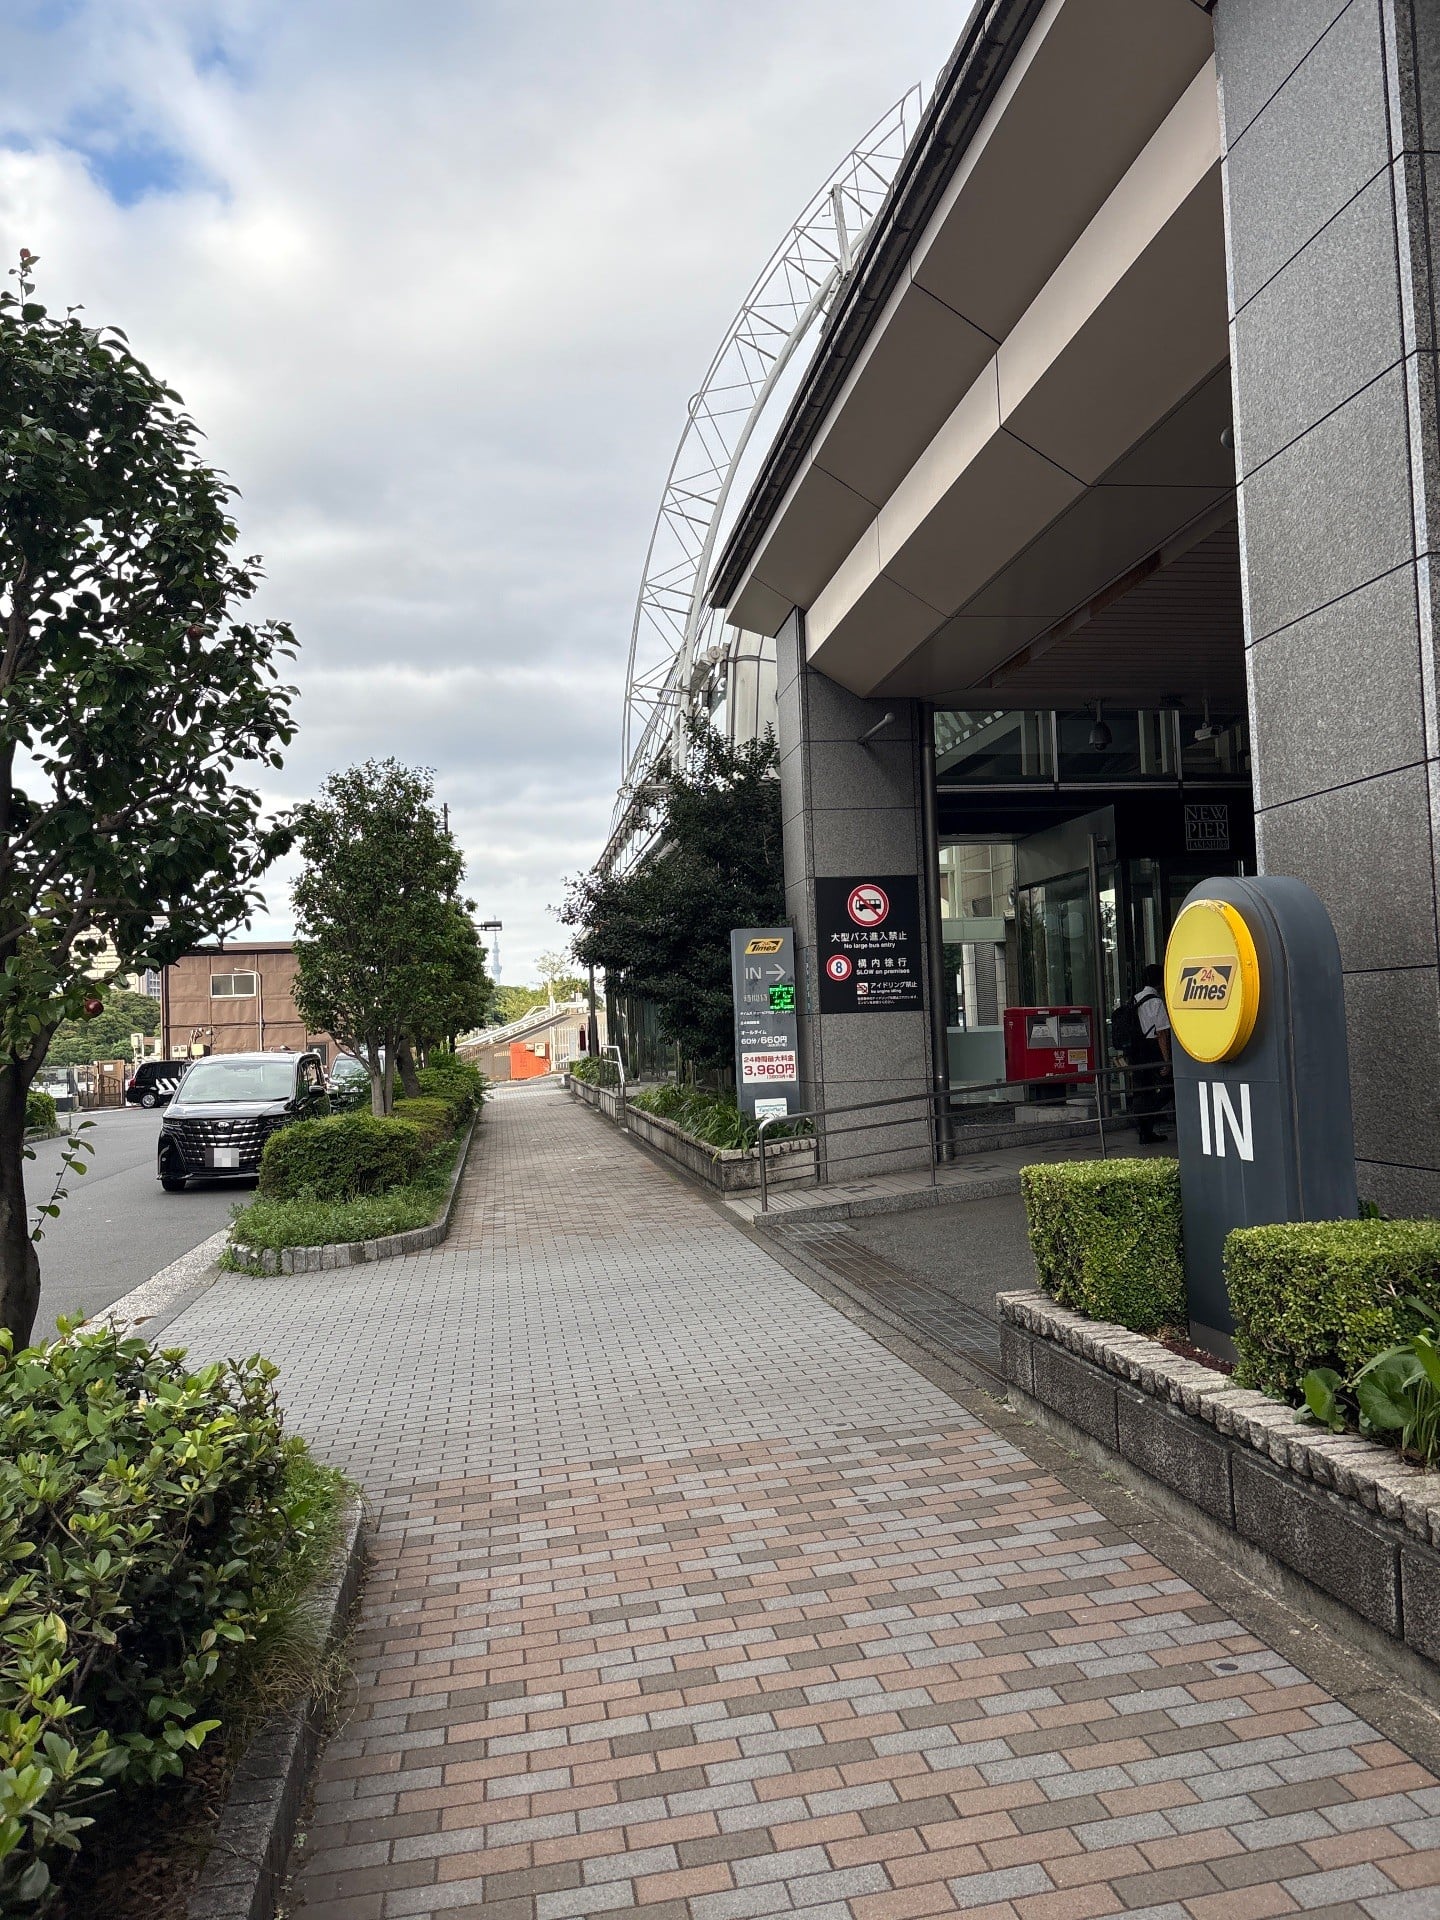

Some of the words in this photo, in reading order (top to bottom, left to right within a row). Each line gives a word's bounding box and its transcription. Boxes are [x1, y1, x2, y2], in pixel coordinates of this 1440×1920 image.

[1187, 807, 1226, 820] NEW
[1187, 822, 1227, 838] PIER
[831, 931, 908, 942] 大型バス進入禁止
[751, 943, 778, 952] Times
[835, 961, 843, 974] 8
[857, 957, 908, 968] 構内徐行
[745, 967, 762, 980] IN
[870, 981, 918, 989] アイドリング禁止
[1182, 973, 1228, 1001] Times
[769, 984, 795, 1010] 空
[743, 1054, 794, 1063] 24時間最大料金
[744, 1064, 795, 1076] 3,960円
[1198, 1081, 1254, 1162] IN
